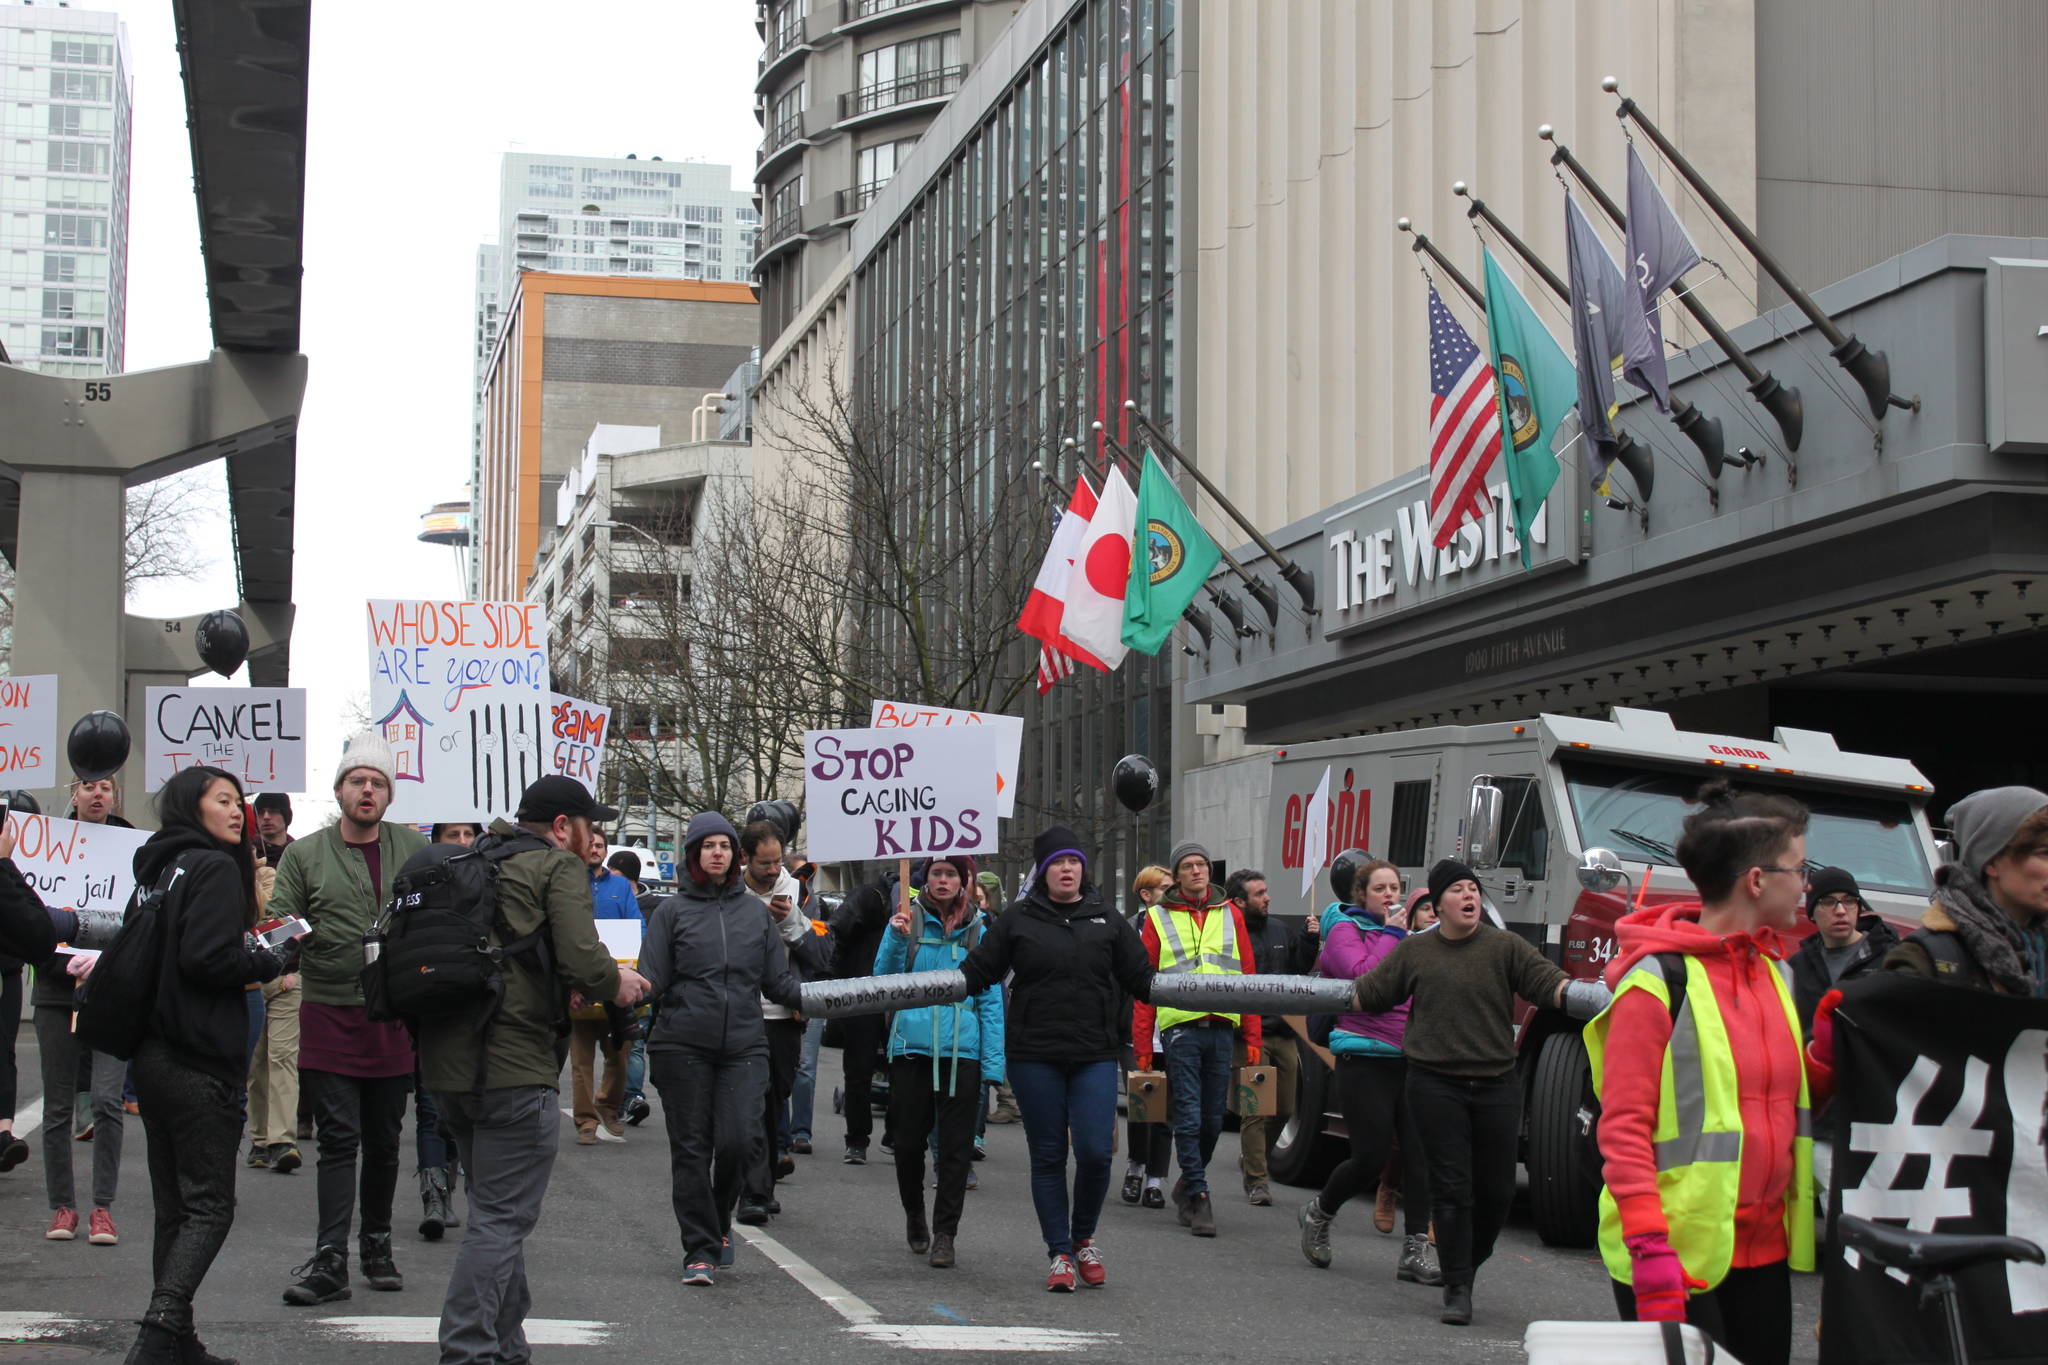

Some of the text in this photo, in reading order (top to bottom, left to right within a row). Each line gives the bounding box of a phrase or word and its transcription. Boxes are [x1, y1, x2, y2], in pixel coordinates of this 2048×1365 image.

[85, 382, 111, 402] 55
[1330, 528, 1396, 611] THE
[165, 621, 181, 633] 54
[367, 602, 540, 648] WHOSE SIDE
[373, 648, 431, 685] ARE
[502, 651, 546, 691] ON?
[0, 680, 30, 709] ON
[157, 693, 301, 744] CANCEL
[201, 742, 234, 757] THE
[811, 735, 915, 781] STOP
[1707, 744, 1772, 760] GARDA
[160, 747, 277, 785] JL!
[841, 785, 936, 816] CAGING
[874, 808, 982, 857] KIDS
[22, 871, 67, 893] our
[77, 874, 116, 908] jail
[396, 892, 421, 911] PESS
[1589, 937, 1621, 964] 34
[923, 984, 954, 999] KIDS
[1177, 981, 1316, 996] NO NEW YOUTH JAIL
